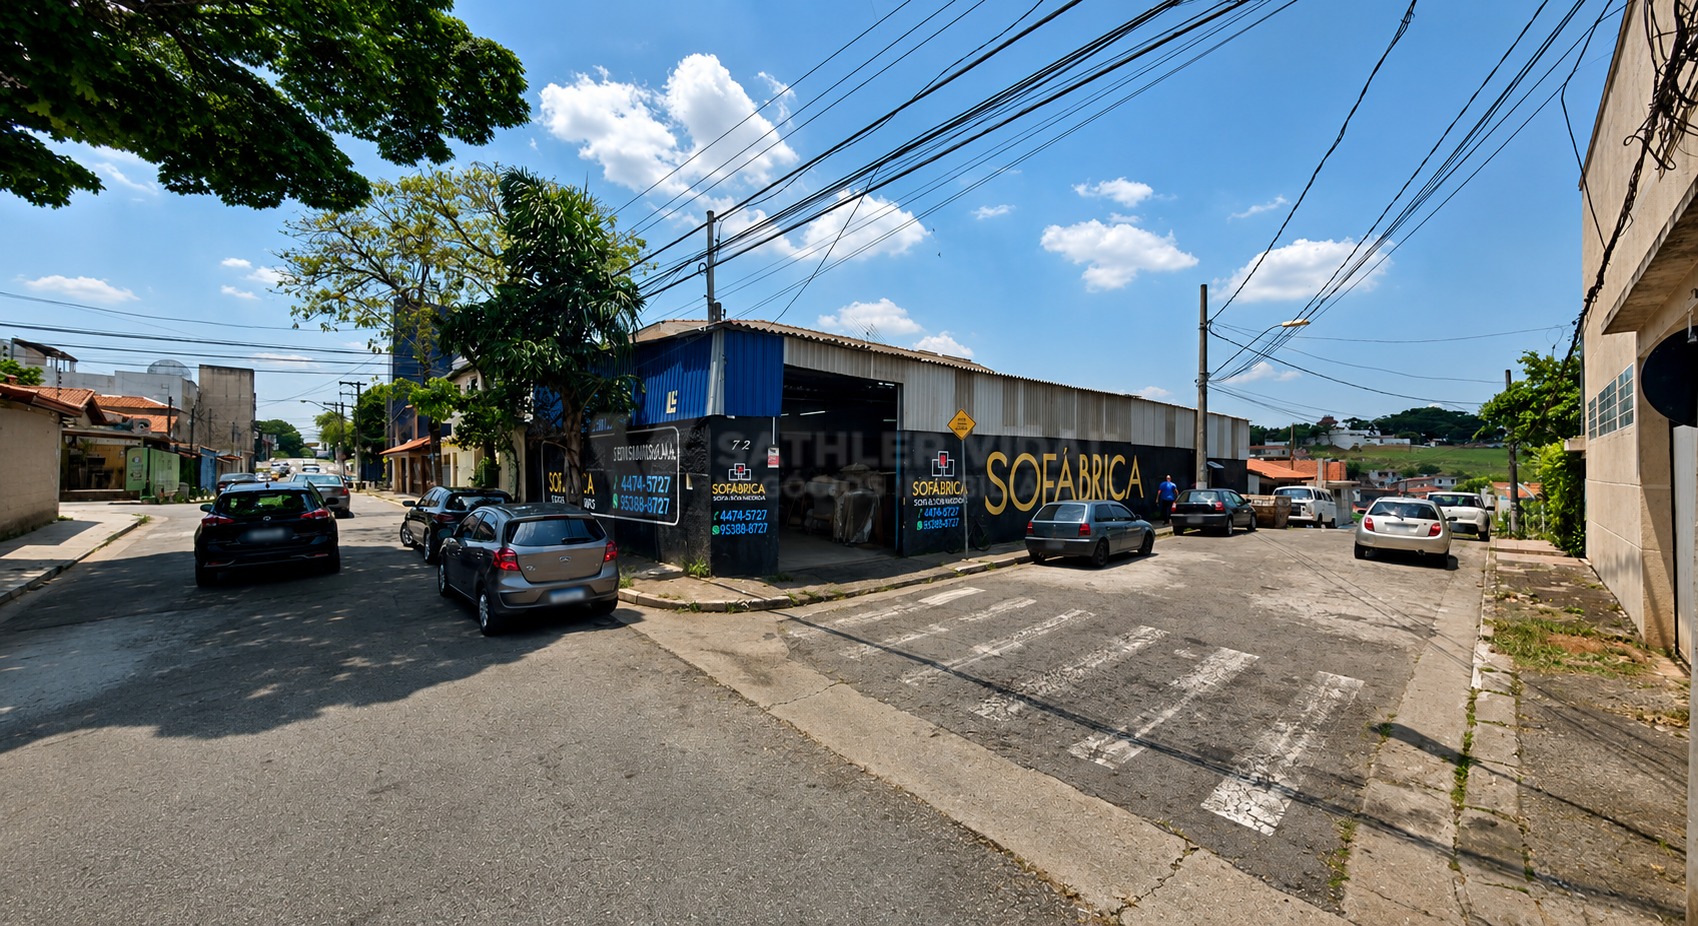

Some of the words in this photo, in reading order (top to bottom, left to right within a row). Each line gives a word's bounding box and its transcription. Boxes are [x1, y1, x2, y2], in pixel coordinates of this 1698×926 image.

[621, 475, 671, 494] 4474-5727
[912, 478, 968, 496] SOFÁBRICA
[984, 447, 1144, 516] SOFÁBRICA
[719, 509, 768, 522] 4474-5727
